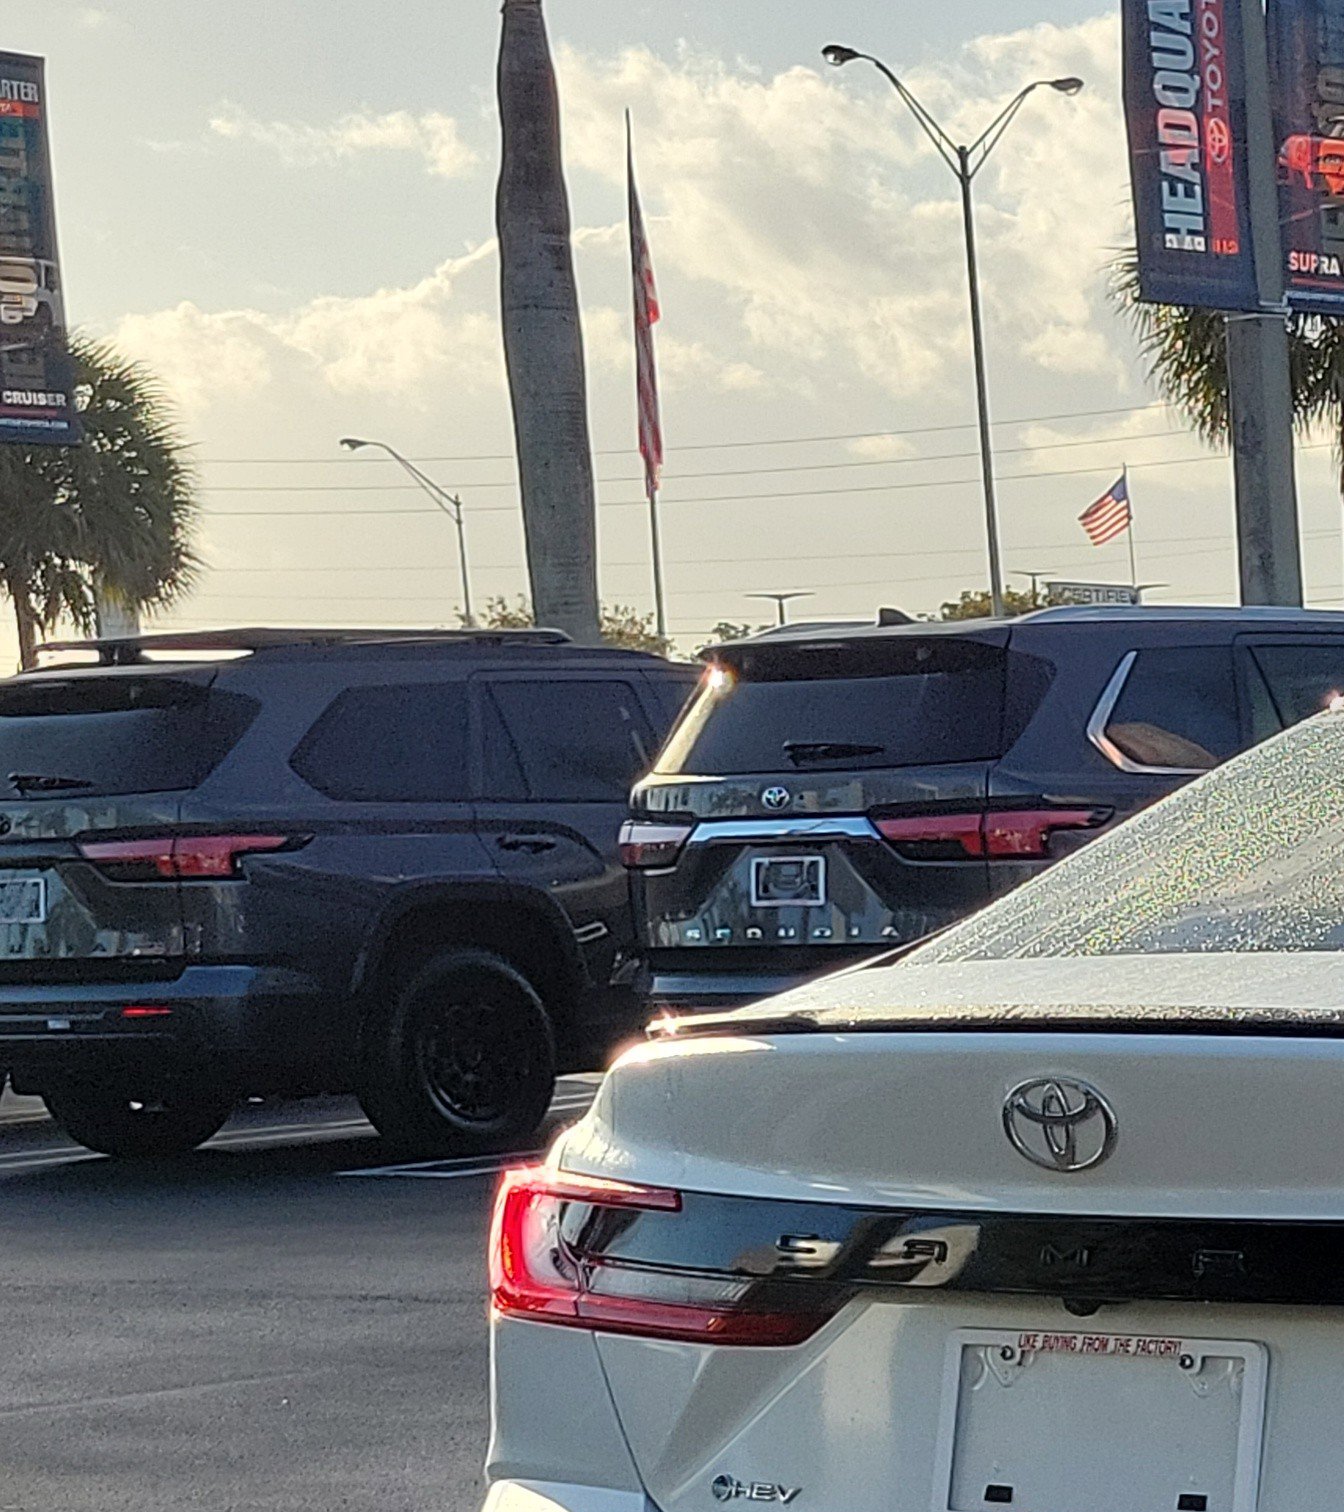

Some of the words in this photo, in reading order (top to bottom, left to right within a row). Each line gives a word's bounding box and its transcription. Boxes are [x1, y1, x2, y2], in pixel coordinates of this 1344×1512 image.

[0, 79, 39, 103] RTER
[1288, 250, 1341, 277] SUPRA
[2, 390, 67, 407] CRUISER
[1017, 1333, 1040, 1350] LIKE
[1041, 1334, 1078, 1351] BUYING
[1080, 1335, 1110, 1354] FROM
[1113, 1337, 1132, 1355] THE
[731, 1480, 803, 1505] HEV
